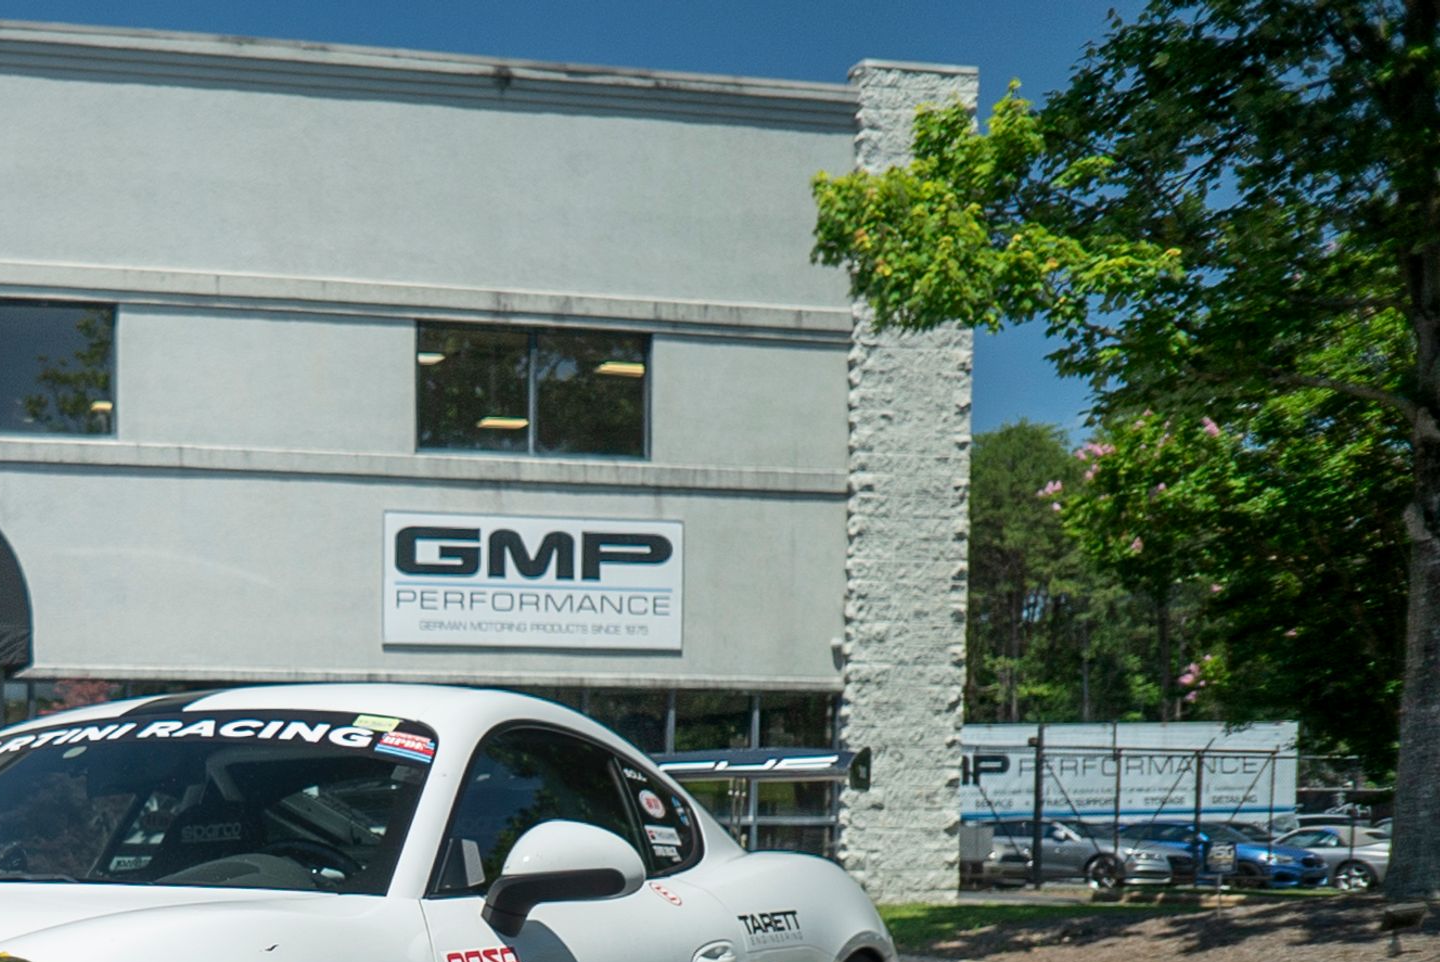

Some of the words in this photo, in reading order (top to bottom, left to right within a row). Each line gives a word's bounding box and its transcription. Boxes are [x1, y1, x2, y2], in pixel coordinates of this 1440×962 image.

[395, 526, 673, 581] GMP
[396, 590, 671, 615] PERFORMANCE
[419, 621, 467, 631] GERMAN
[470, 622, 527, 633] MOTORING
[530, 623, 588, 635] PRODUCTS
[592, 625, 621, 635] SINCE
[136, 719, 376, 748] RACING
[737, 910, 800, 935] TARETT
